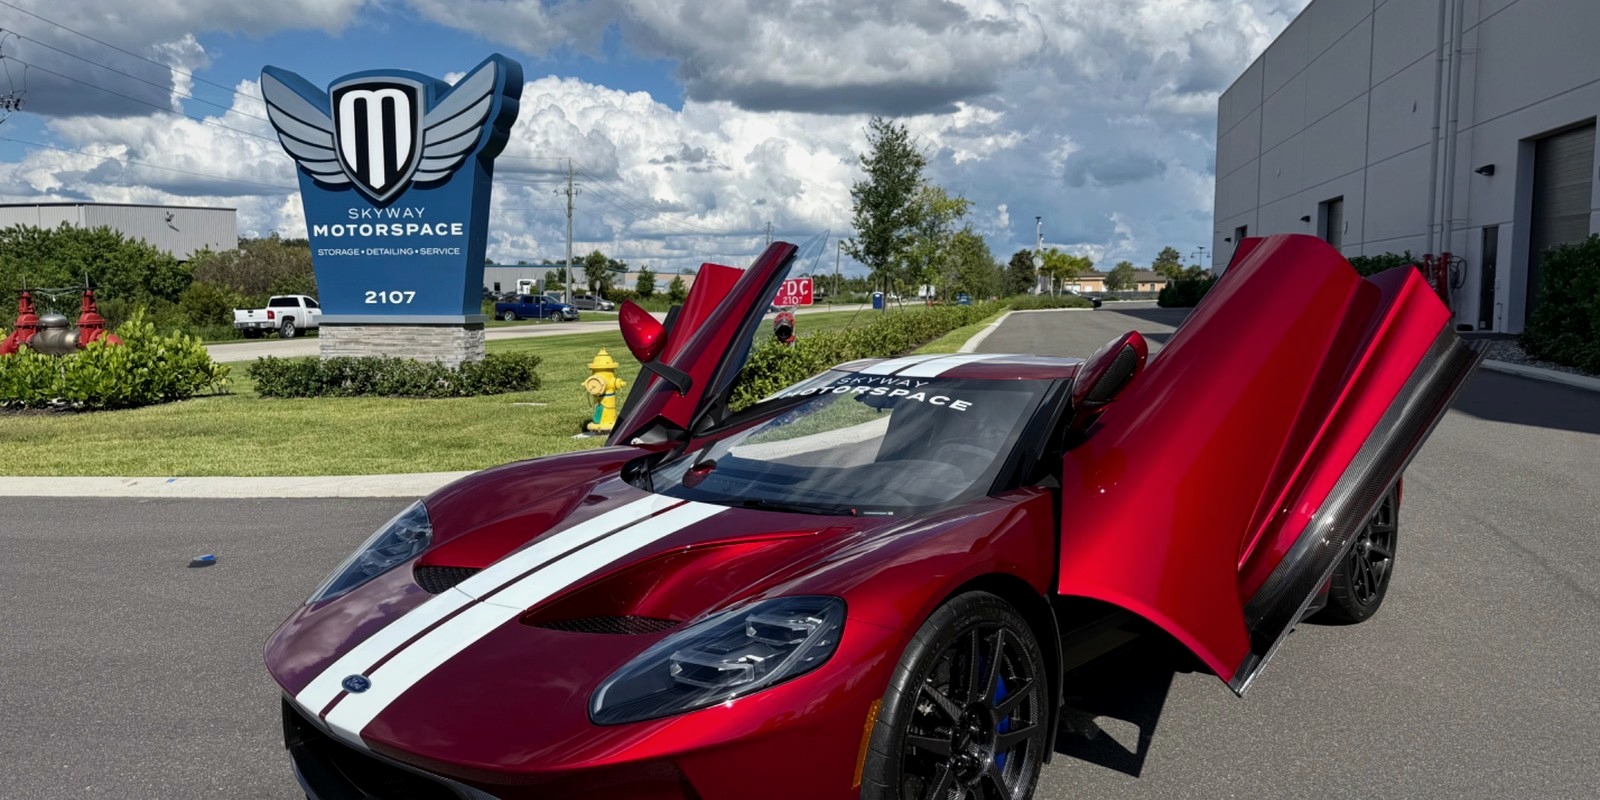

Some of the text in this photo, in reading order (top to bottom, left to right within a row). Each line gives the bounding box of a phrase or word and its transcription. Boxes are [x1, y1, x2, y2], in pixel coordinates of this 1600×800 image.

[348, 207, 425, 220] SKYWAY
[313, 223, 464, 237] MOTORSPACE
[317, 247, 461, 256] STORAGE DETAILING SERVICE
[364, 290, 416, 304] 2107
[782, 296, 803, 305] 2107
[836, 376, 929, 388] SKYWAY
